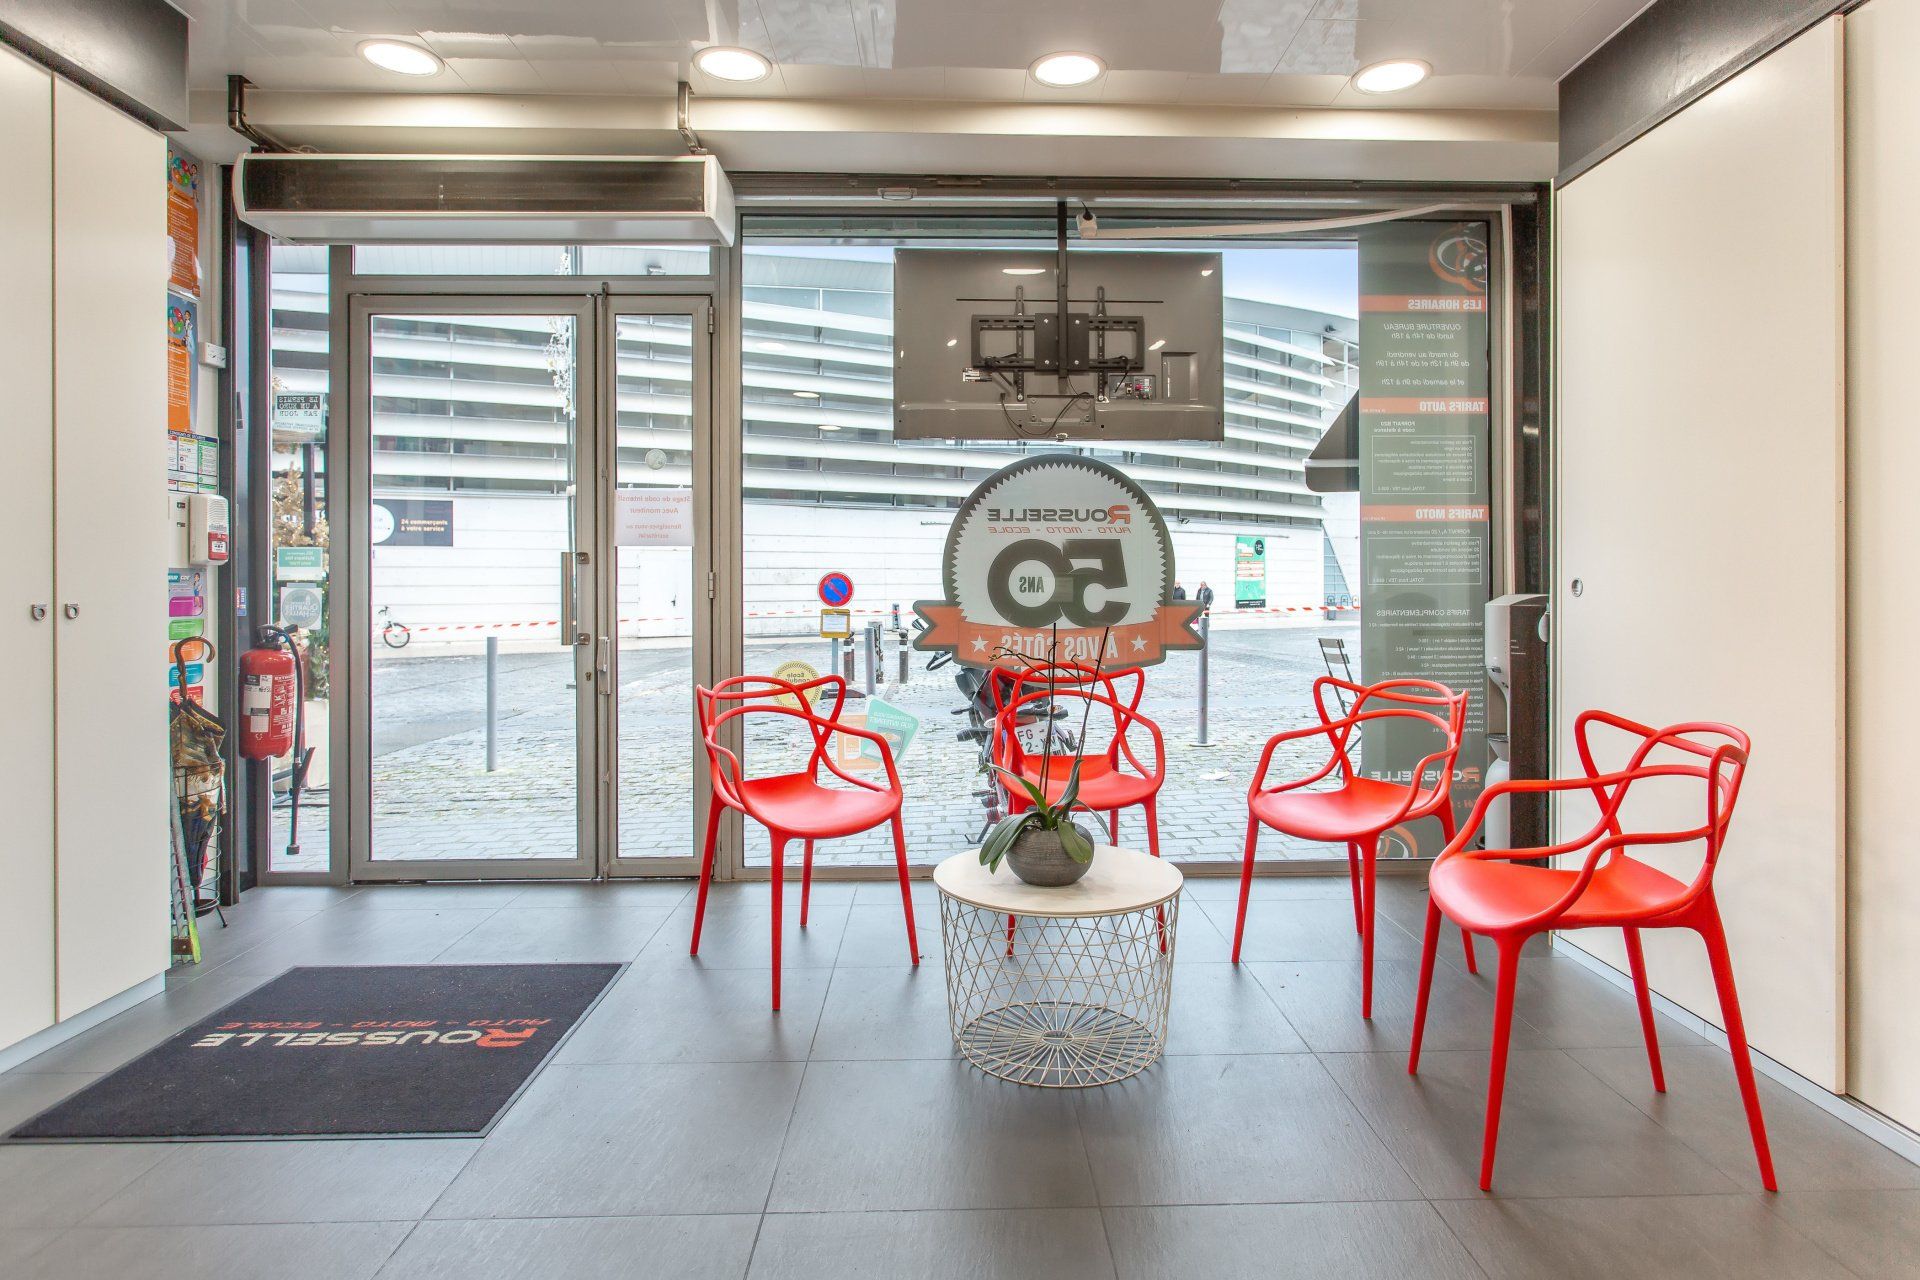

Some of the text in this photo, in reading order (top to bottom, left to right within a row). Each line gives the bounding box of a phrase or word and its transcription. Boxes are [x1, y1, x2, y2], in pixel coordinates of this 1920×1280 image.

[216, 1018, 551, 1029] AUTO MOTO ECOLE
[190, 1026, 538, 1048] ROUSSELLE
